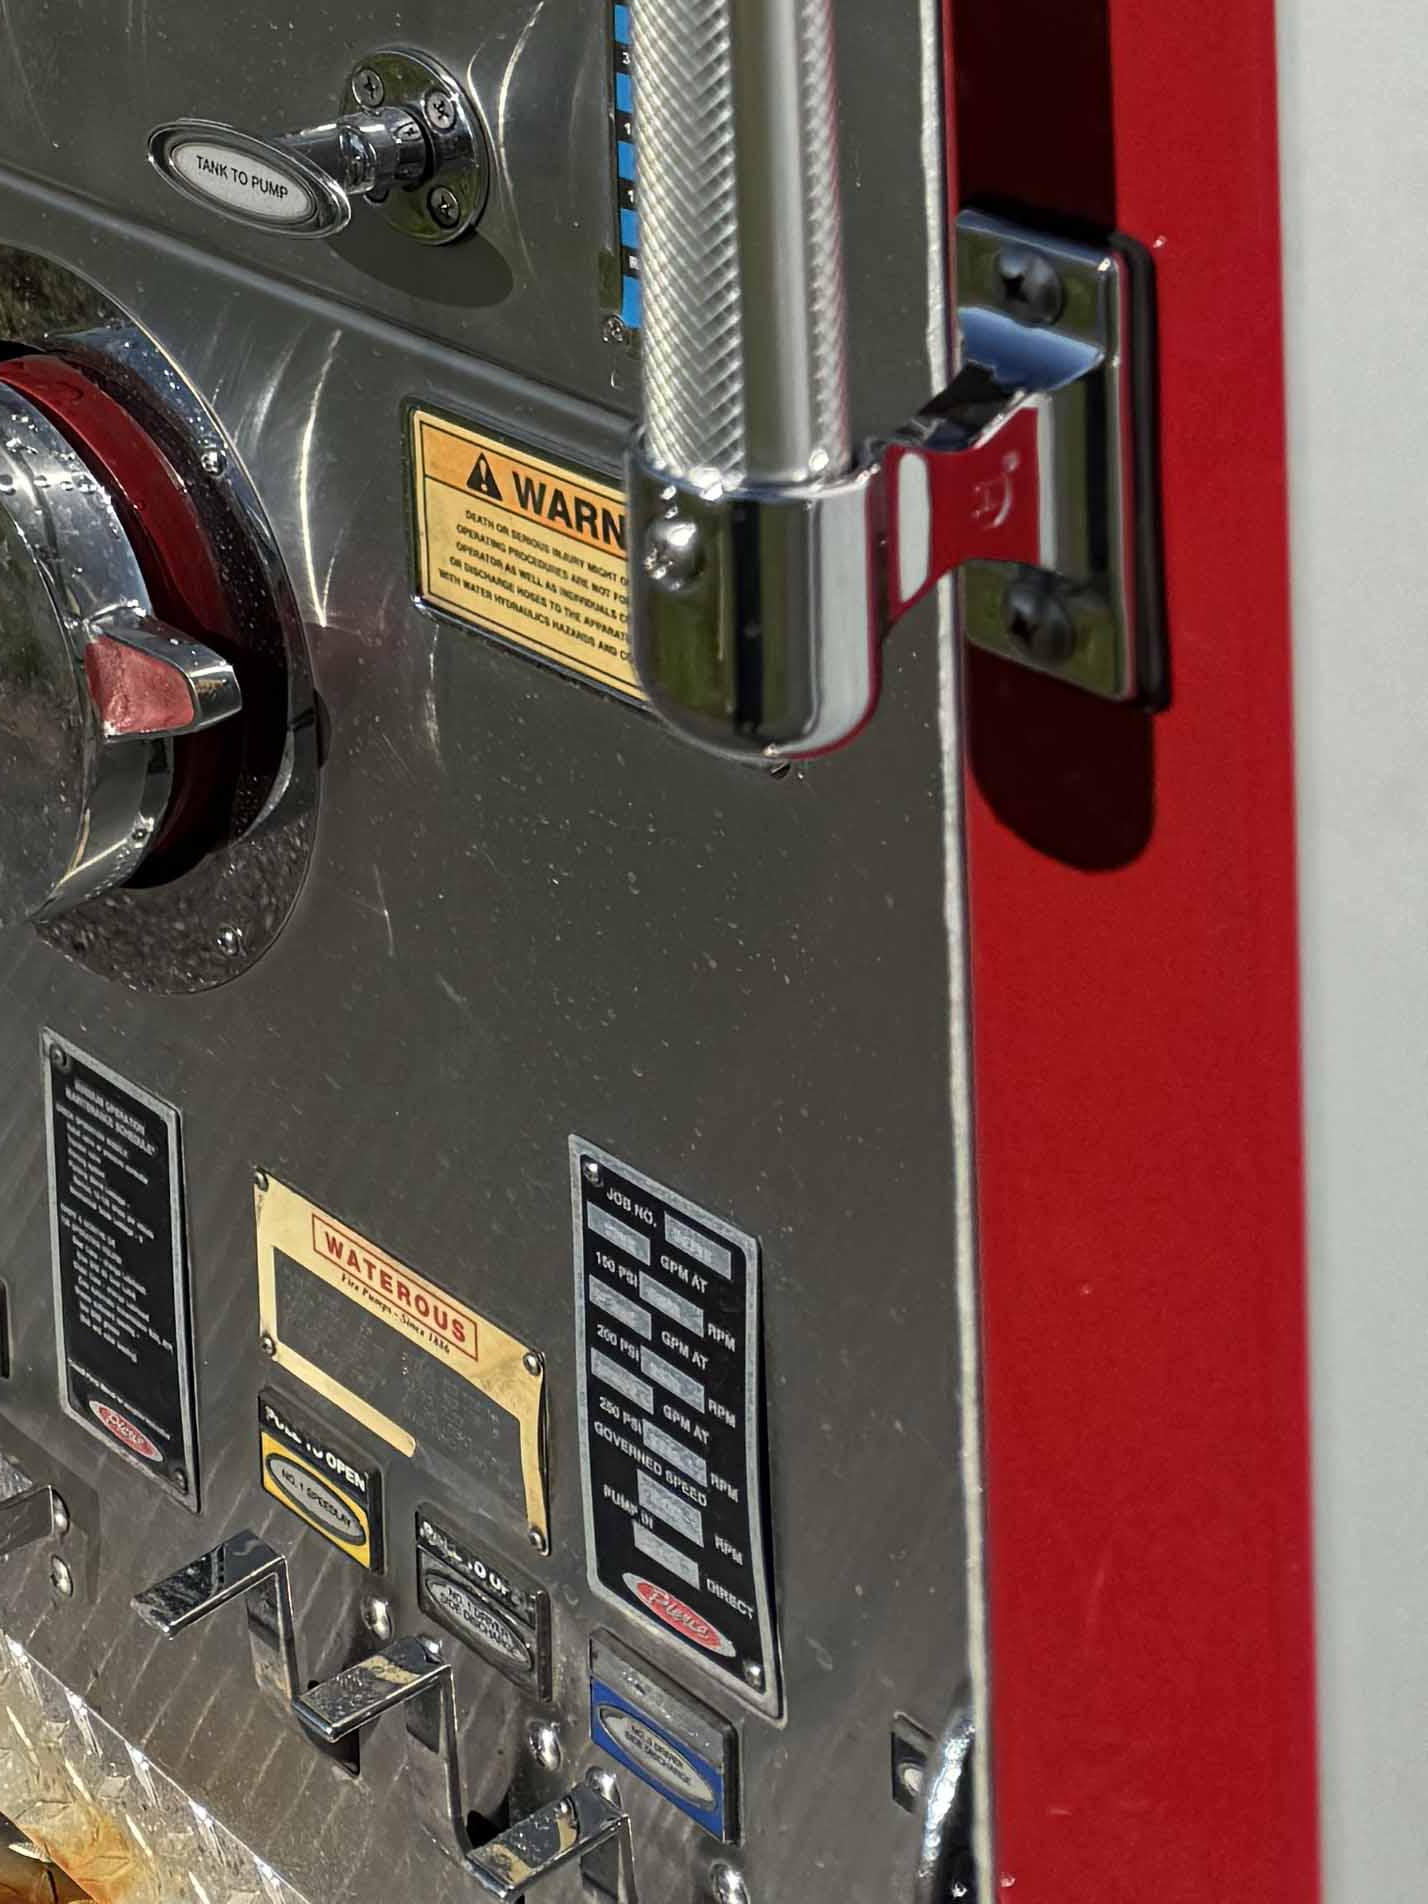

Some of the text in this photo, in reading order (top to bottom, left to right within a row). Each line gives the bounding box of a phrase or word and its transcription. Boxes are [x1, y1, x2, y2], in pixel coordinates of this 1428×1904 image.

[195, 154, 289, 199] TANK TO PUMP
[511, 470, 628, 553] WARN
[456, 523, 506, 552] OPERATING
[508, 546, 569, 580] PROCEDURES
[571, 573, 590, 590] ARE
[592, 582, 611, 598] NOT
[466, 509, 494, 529] DEATH
[496, 523, 510, 536] OR
[511, 529, 550, 555] SERIOUS
[552, 546, 585, 569] INJURY
[587, 561, 617, 582] MIGHT
[438, 568, 461, 585] WITH
[462, 579, 492, 600] WATER
[494, 593, 550, 626] HYDRAULICS
[552, 619, 595, 648] HAZARDS
[598, 640, 618, 657] AND
[449, 556, 462, 568] OR
[464, 562, 515, 594] DISCHARGE
[517, 586, 547, 608] HOSES
[550, 600, 562, 614] TO
[564, 605, 581, 623] THE
[584, 615, 629, 642] APPARAT
[456, 541, 504, 569] OPERATOR
[505, 563, 517, 576] AS
[519, 568, 543, 587] WELL
[546, 580, 557, 594] AS
[560, 586, 617, 621] INDIVIDUALS
[606, 1188, 657, 1227] JOB NO.
[324, 1230, 467, 1344] WATEROUS
[341, 1274, 359, 1297] Fire
[362, 1287, 392, 1316] Pumps
[400, 1314, 424, 1337] Since
[596, 1251, 735, 1352] 150 PSI RPM
[661, 1254, 709, 1294] GPM AT
[597, 1324, 735, 1427] 200 PSI RPM
[661, 1330, 710, 1370] GPM AT
[599, 1396, 739, 1504] 250 PSI RPM
[663, 1404, 710, 1445] GPM AT
[325, 1454, 365, 1492] OPEN
[594, 1421, 708, 1507] GOVERNED SPEED
[306, 1487, 351, 1529] SPEEDLAY
[603, 1483, 638, 1519] PUMP
[715, 1535, 743, 1566] RPM
[646, 1588, 710, 1638] Pierce
[706, 1577, 753, 1620] DIRECT
